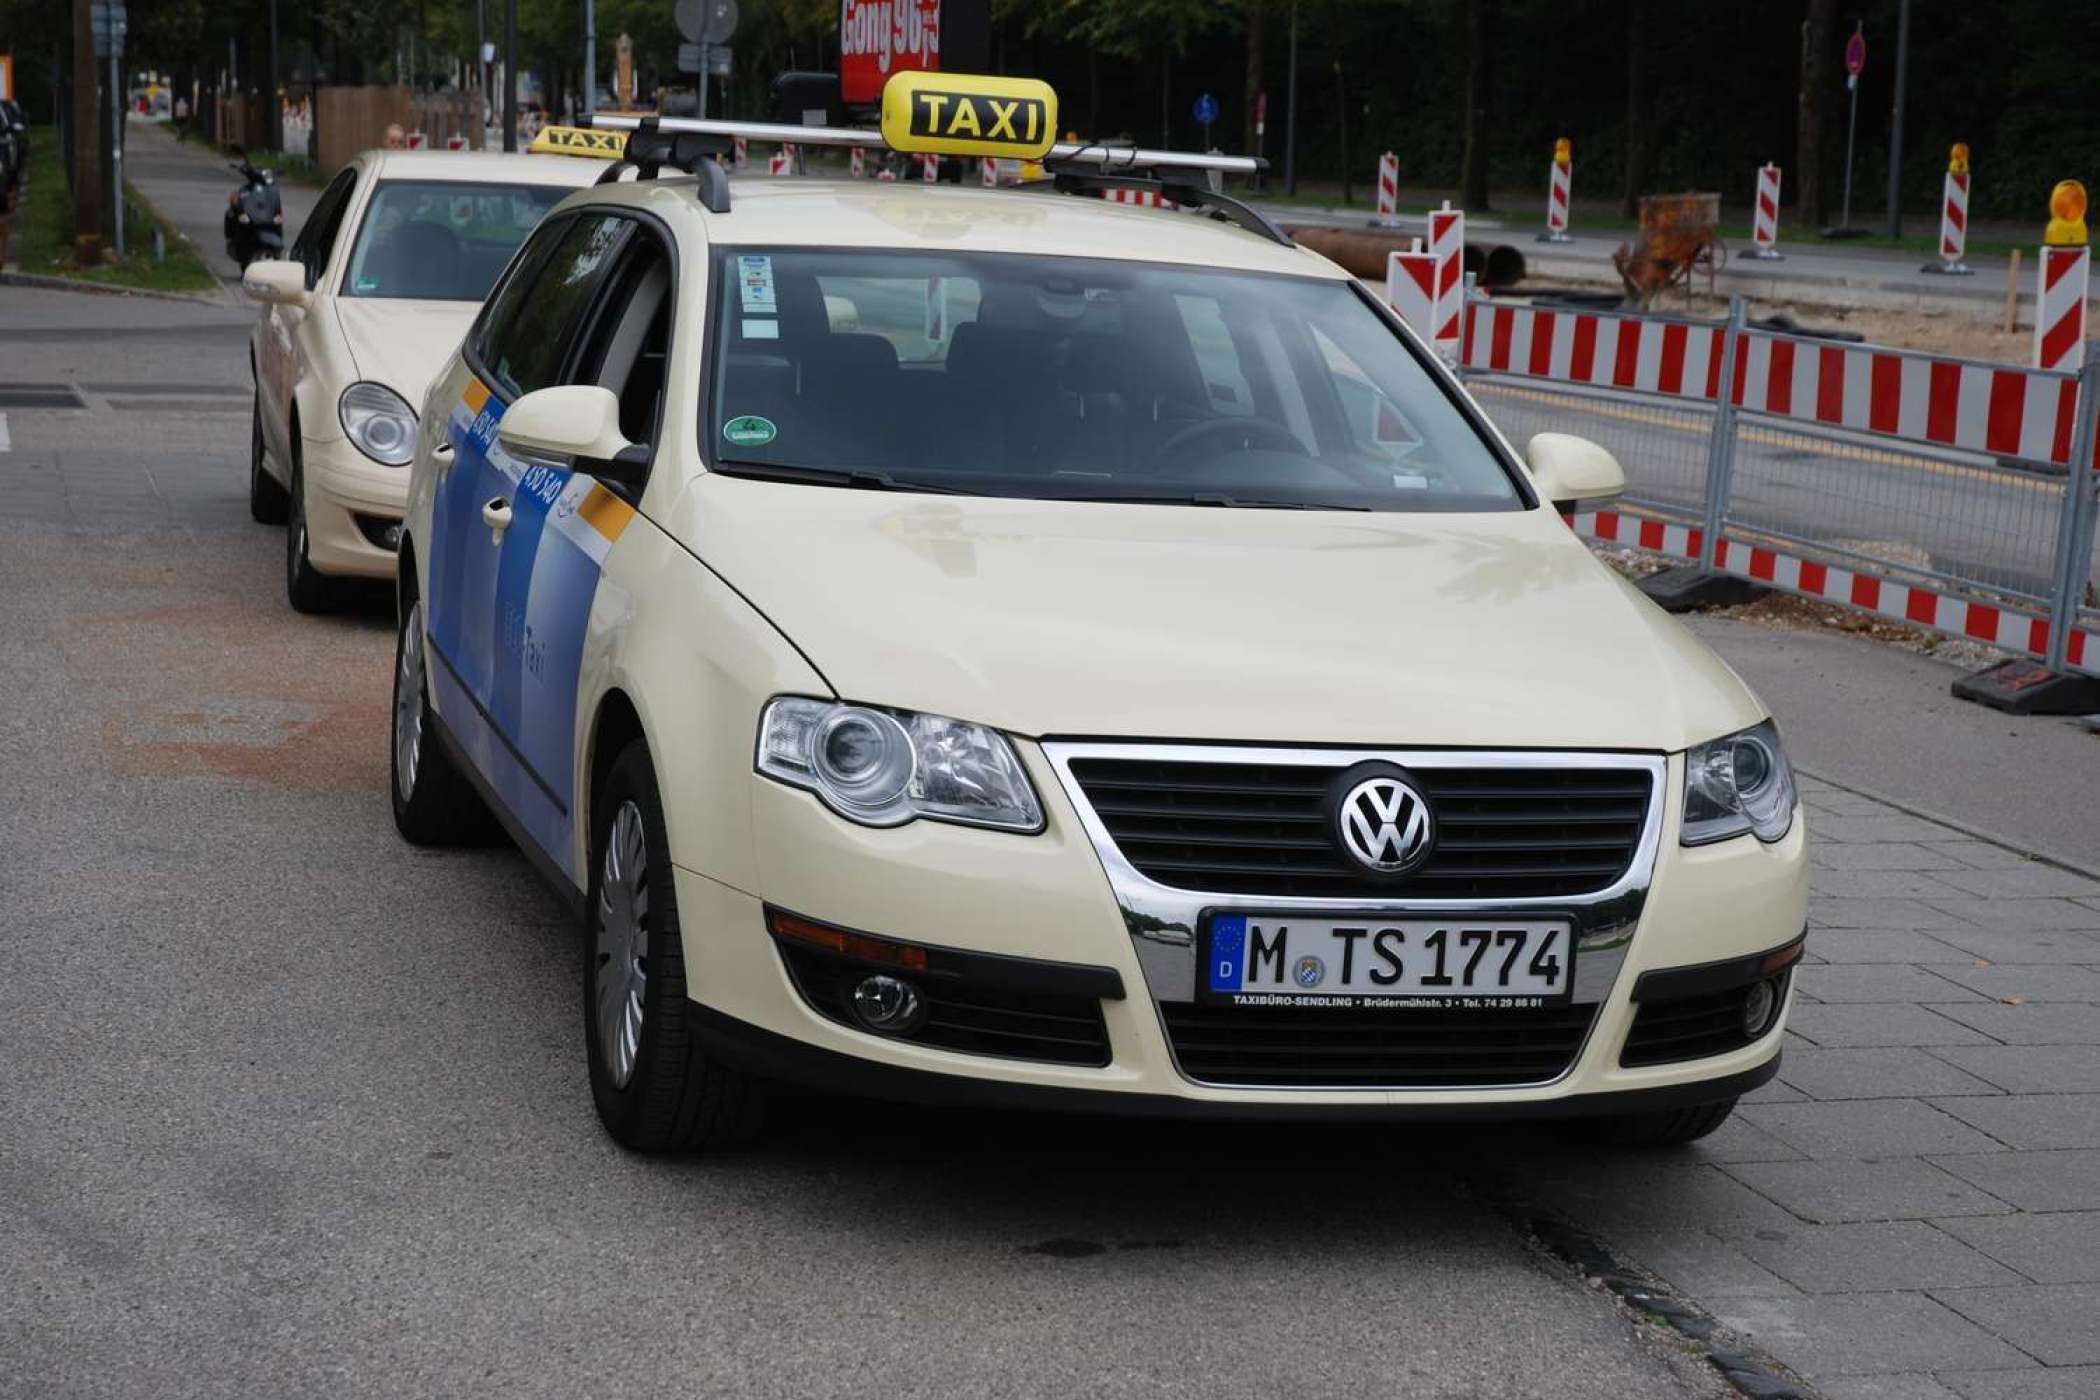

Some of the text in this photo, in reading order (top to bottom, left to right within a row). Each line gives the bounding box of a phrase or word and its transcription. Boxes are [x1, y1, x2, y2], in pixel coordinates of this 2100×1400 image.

[549, 129, 622, 151] TAXI
[919, 94, 1037, 141] TAXI
[1248, 926, 1561, 987] M TS 1774
